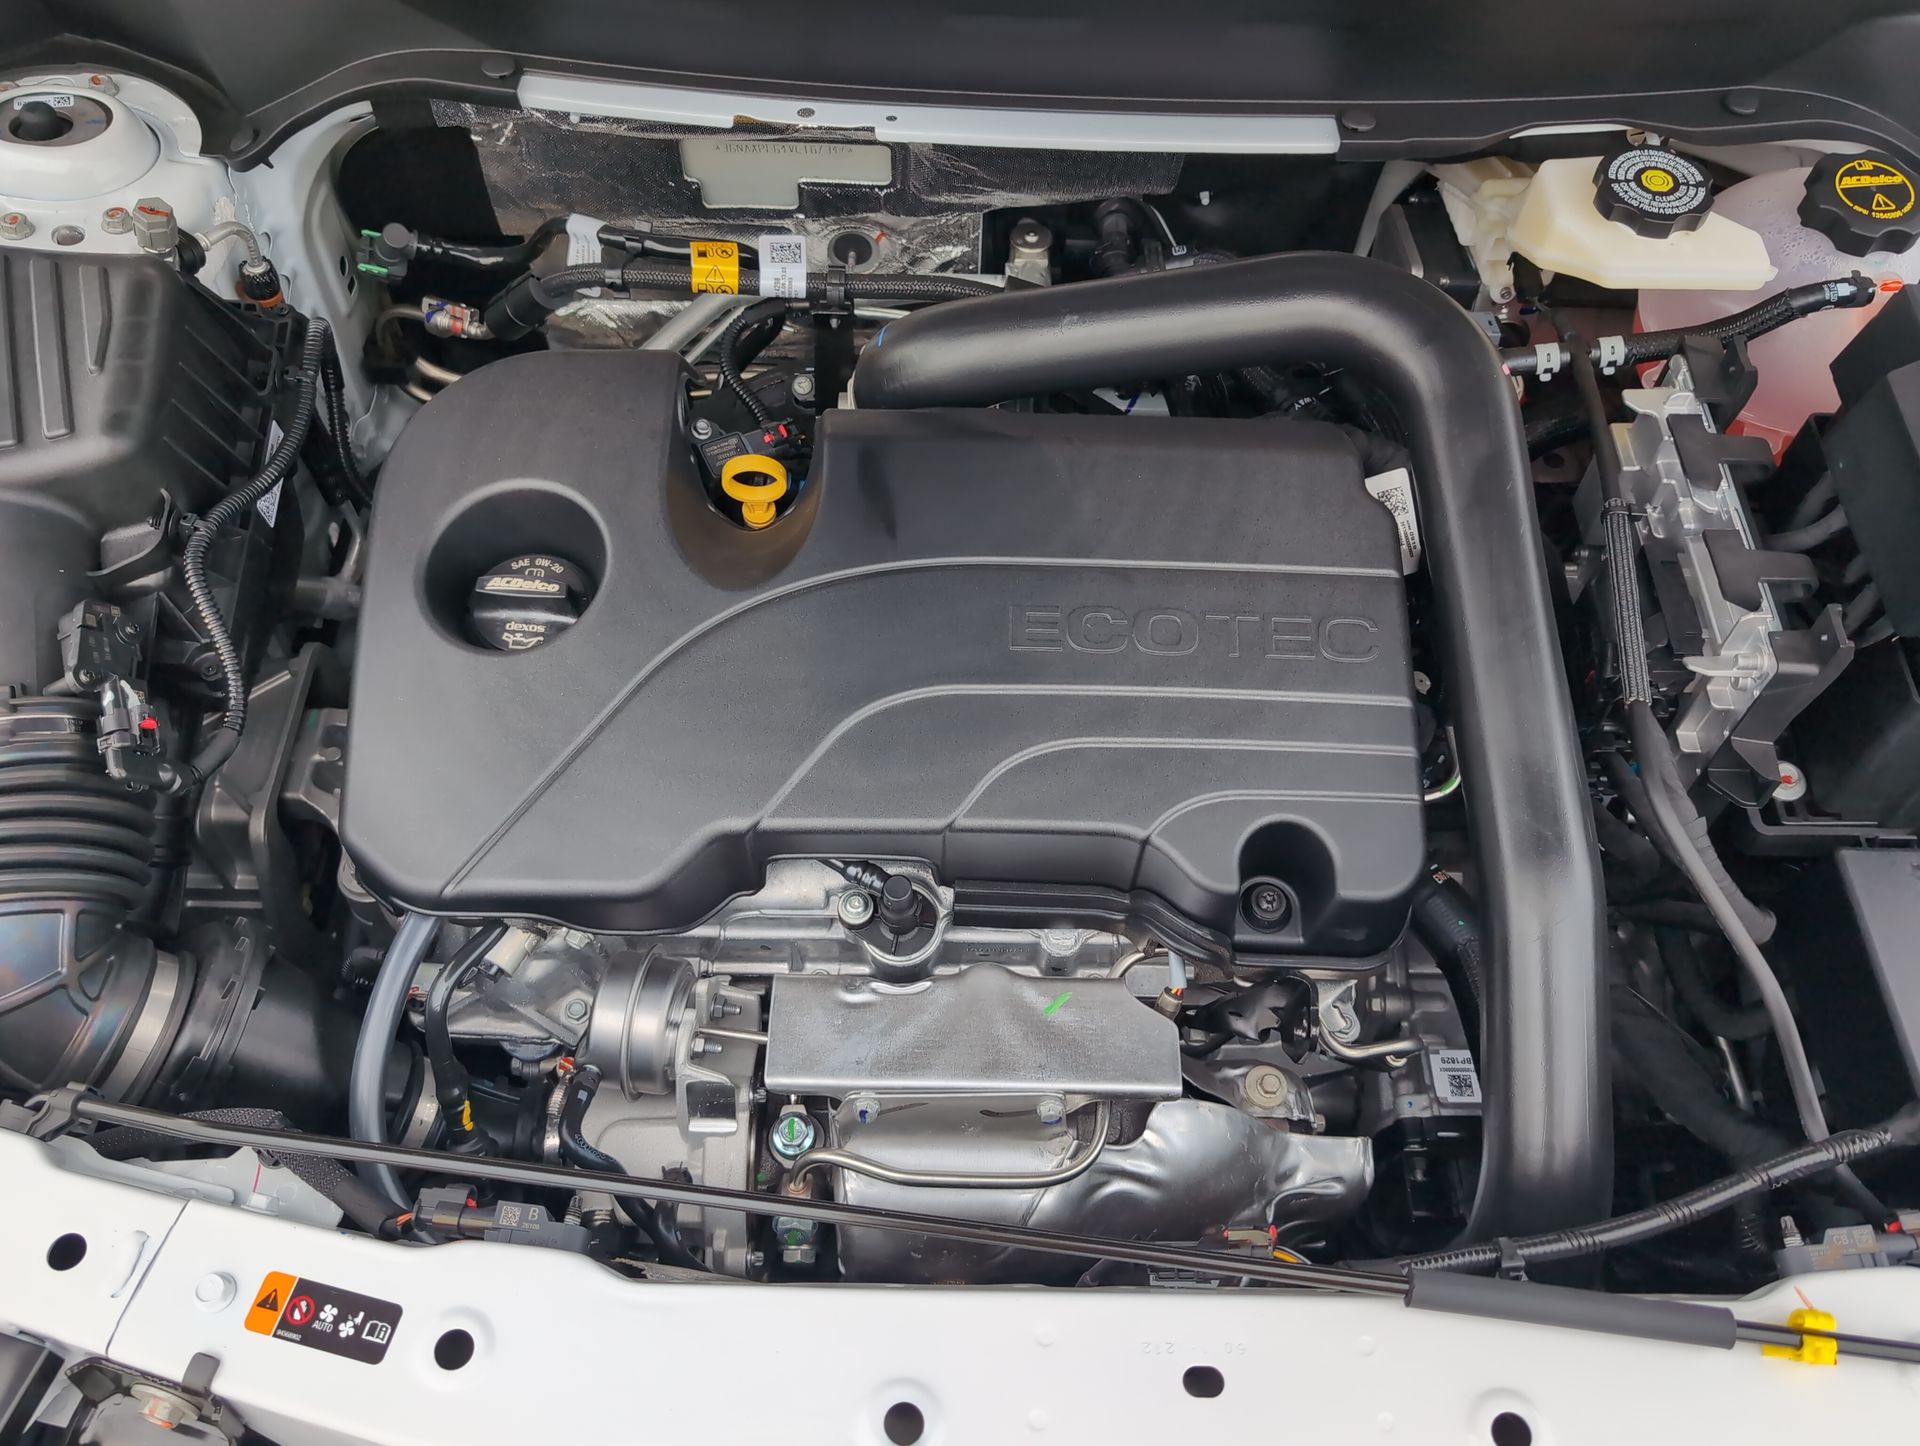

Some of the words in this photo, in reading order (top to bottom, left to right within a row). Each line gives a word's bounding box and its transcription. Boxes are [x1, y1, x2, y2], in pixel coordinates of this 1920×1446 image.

[1841, 175, 1903, 185] ACDelco
[511, 558, 530, 569] SAE
[535, 558, 564, 573] 0W-20
[486, 577, 560, 592] ACDelco
[505, 621, 545, 632] dexos
[1009, 605, 1379, 663] ECOTEC
[528, 1207, 539, 1220] B
[311, 1320, 334, 1333] AUTO
